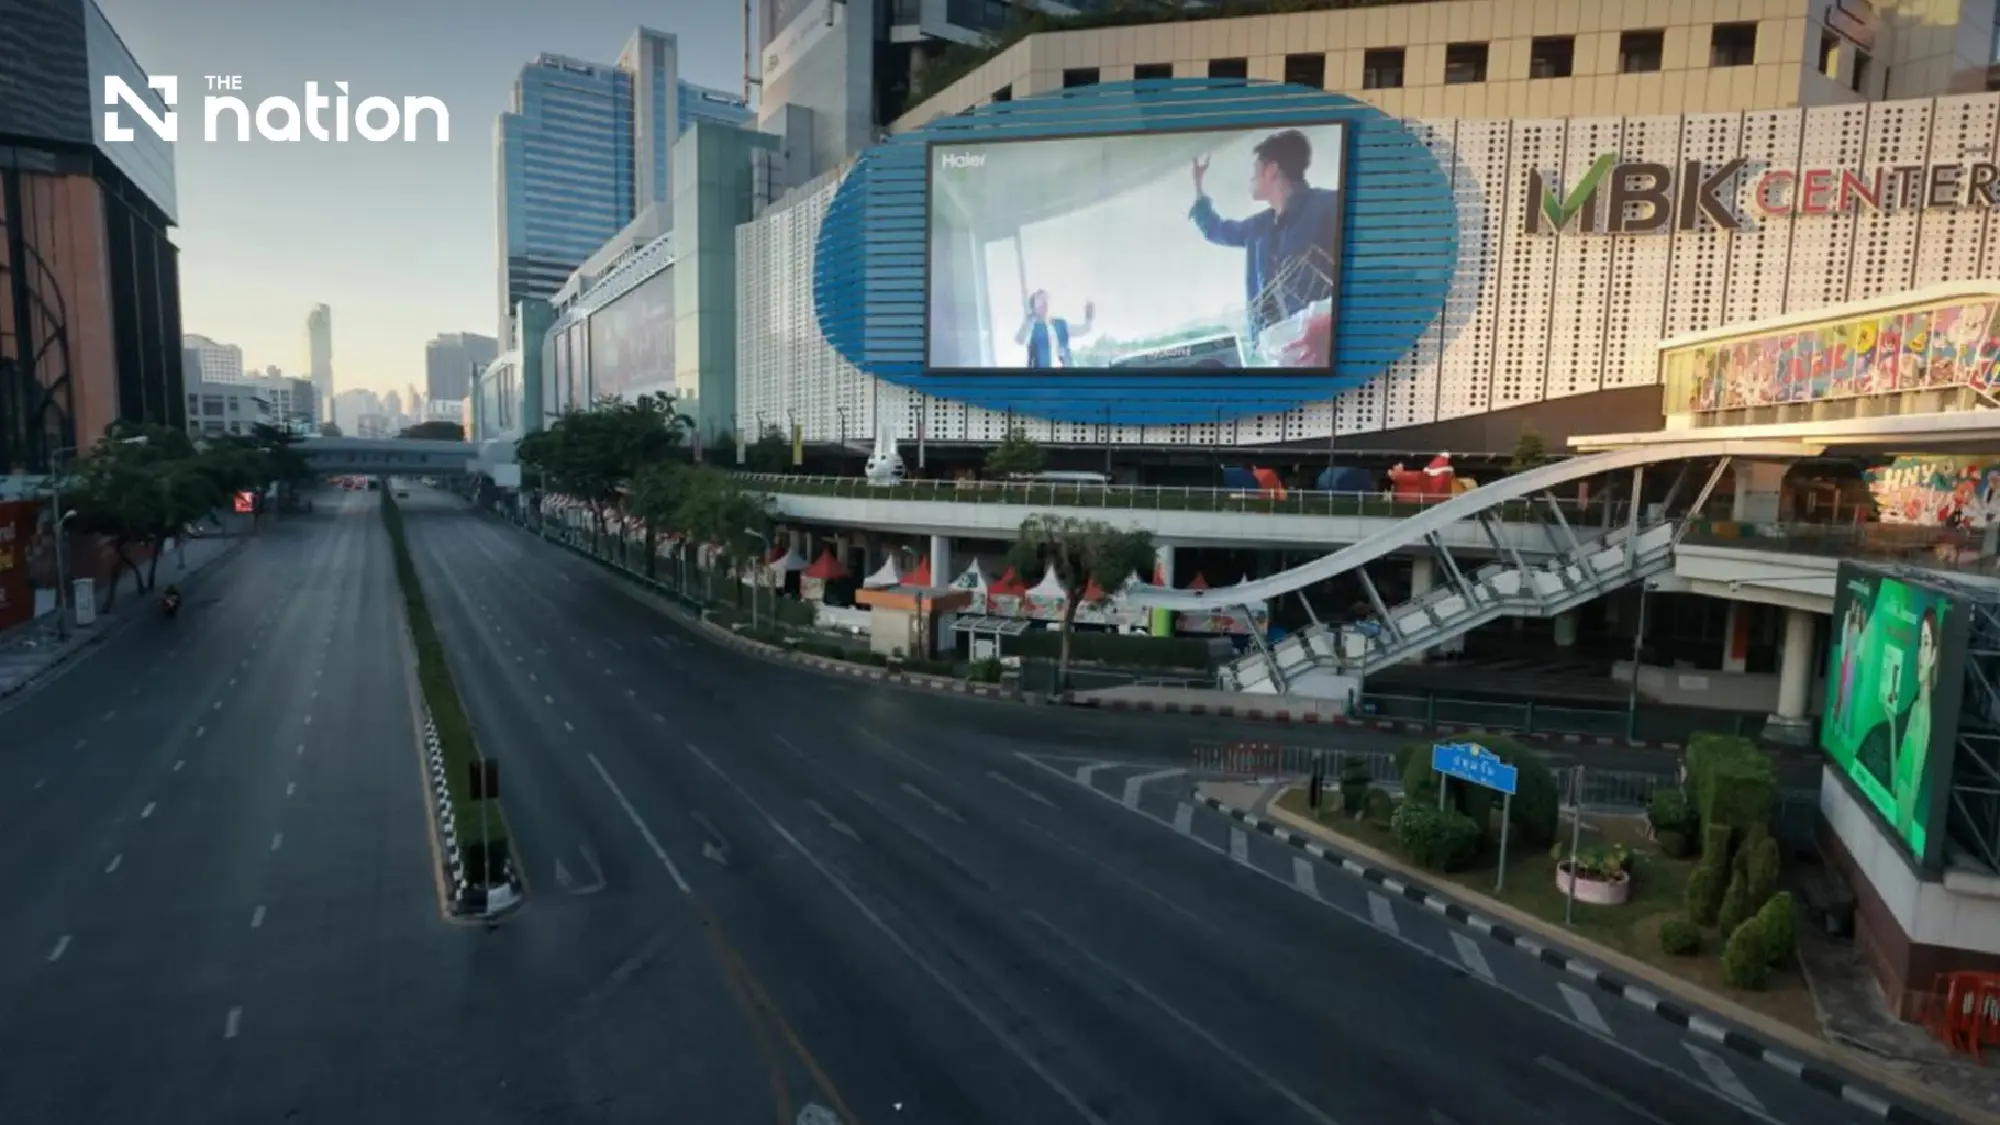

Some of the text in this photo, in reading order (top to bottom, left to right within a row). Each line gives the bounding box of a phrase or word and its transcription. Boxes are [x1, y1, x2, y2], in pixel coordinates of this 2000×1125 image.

[941, 151, 988, 170] Haier
[1523, 152, 1999, 235] MBK CENTER
